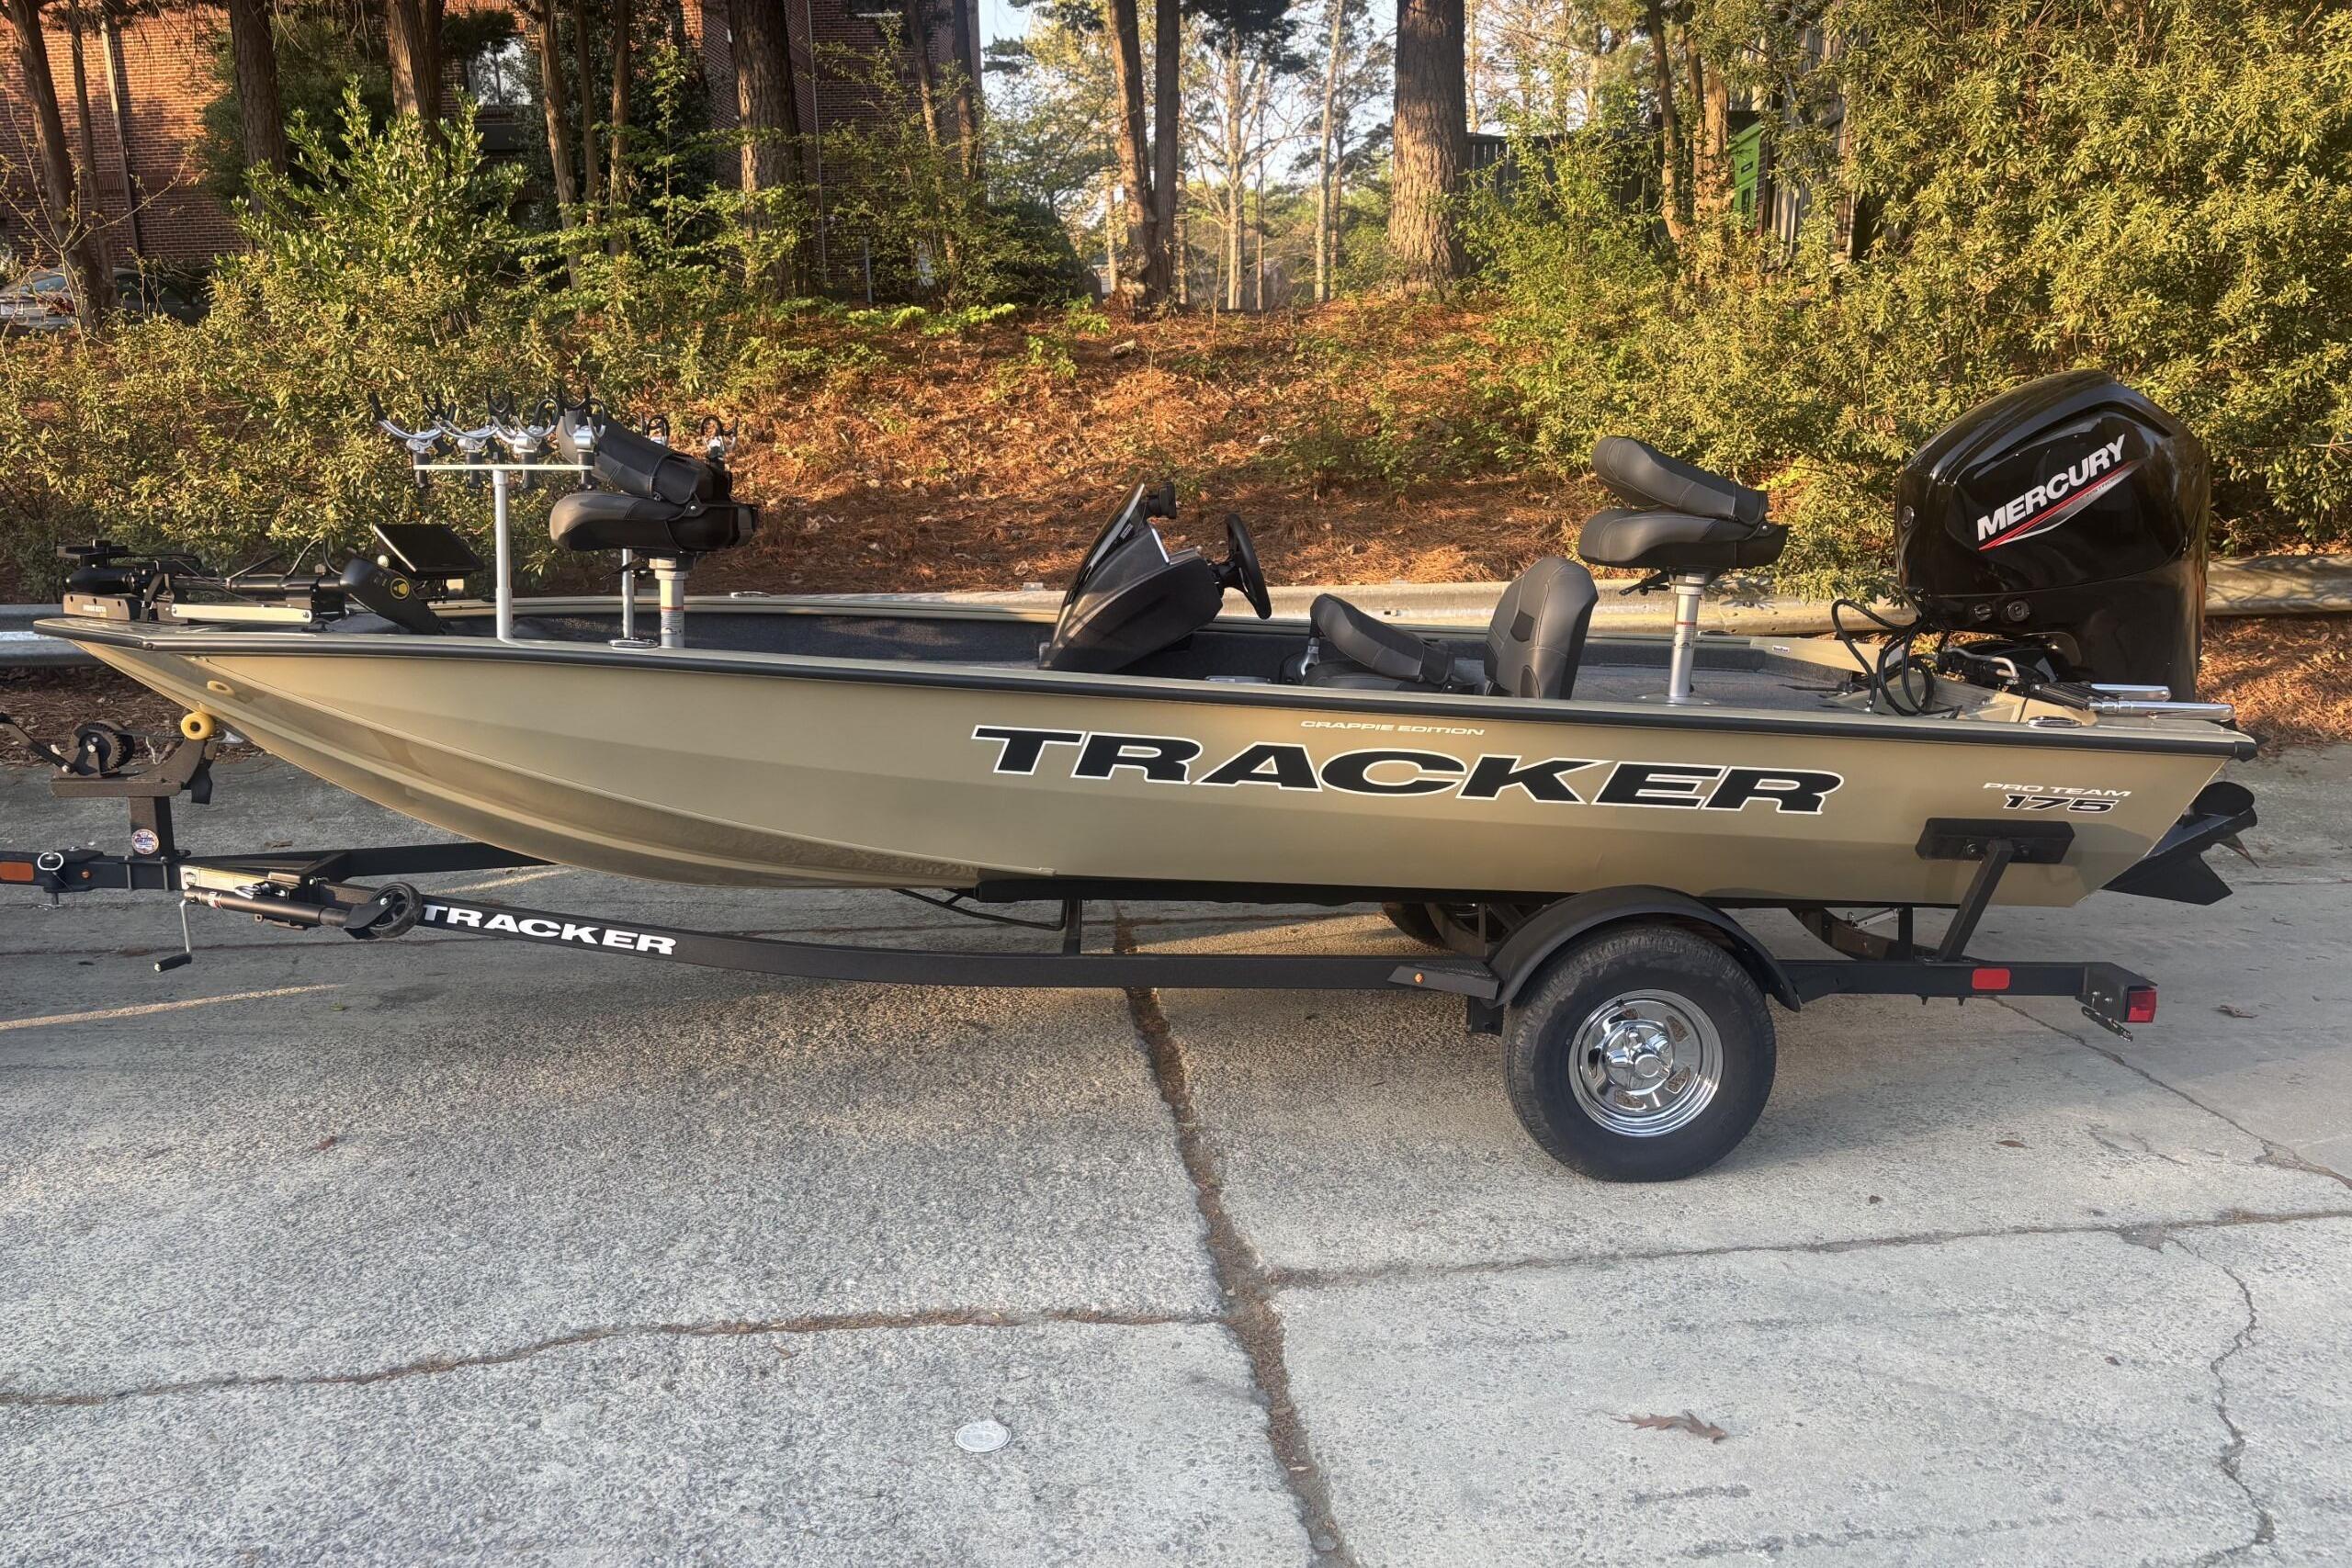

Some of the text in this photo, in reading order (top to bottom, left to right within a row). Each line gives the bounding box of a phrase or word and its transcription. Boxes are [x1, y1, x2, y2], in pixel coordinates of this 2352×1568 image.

[1977, 434, 2125, 541] MERCURY
[1301, 721, 1485, 736] CRAPPIE EDITION
[971, 724, 1844, 815] TRACKER
[1983, 783, 2132, 797] PRO TEAM
[2003, 793, 2119, 814] 175
[423, 904, 676, 955] TRACKER
